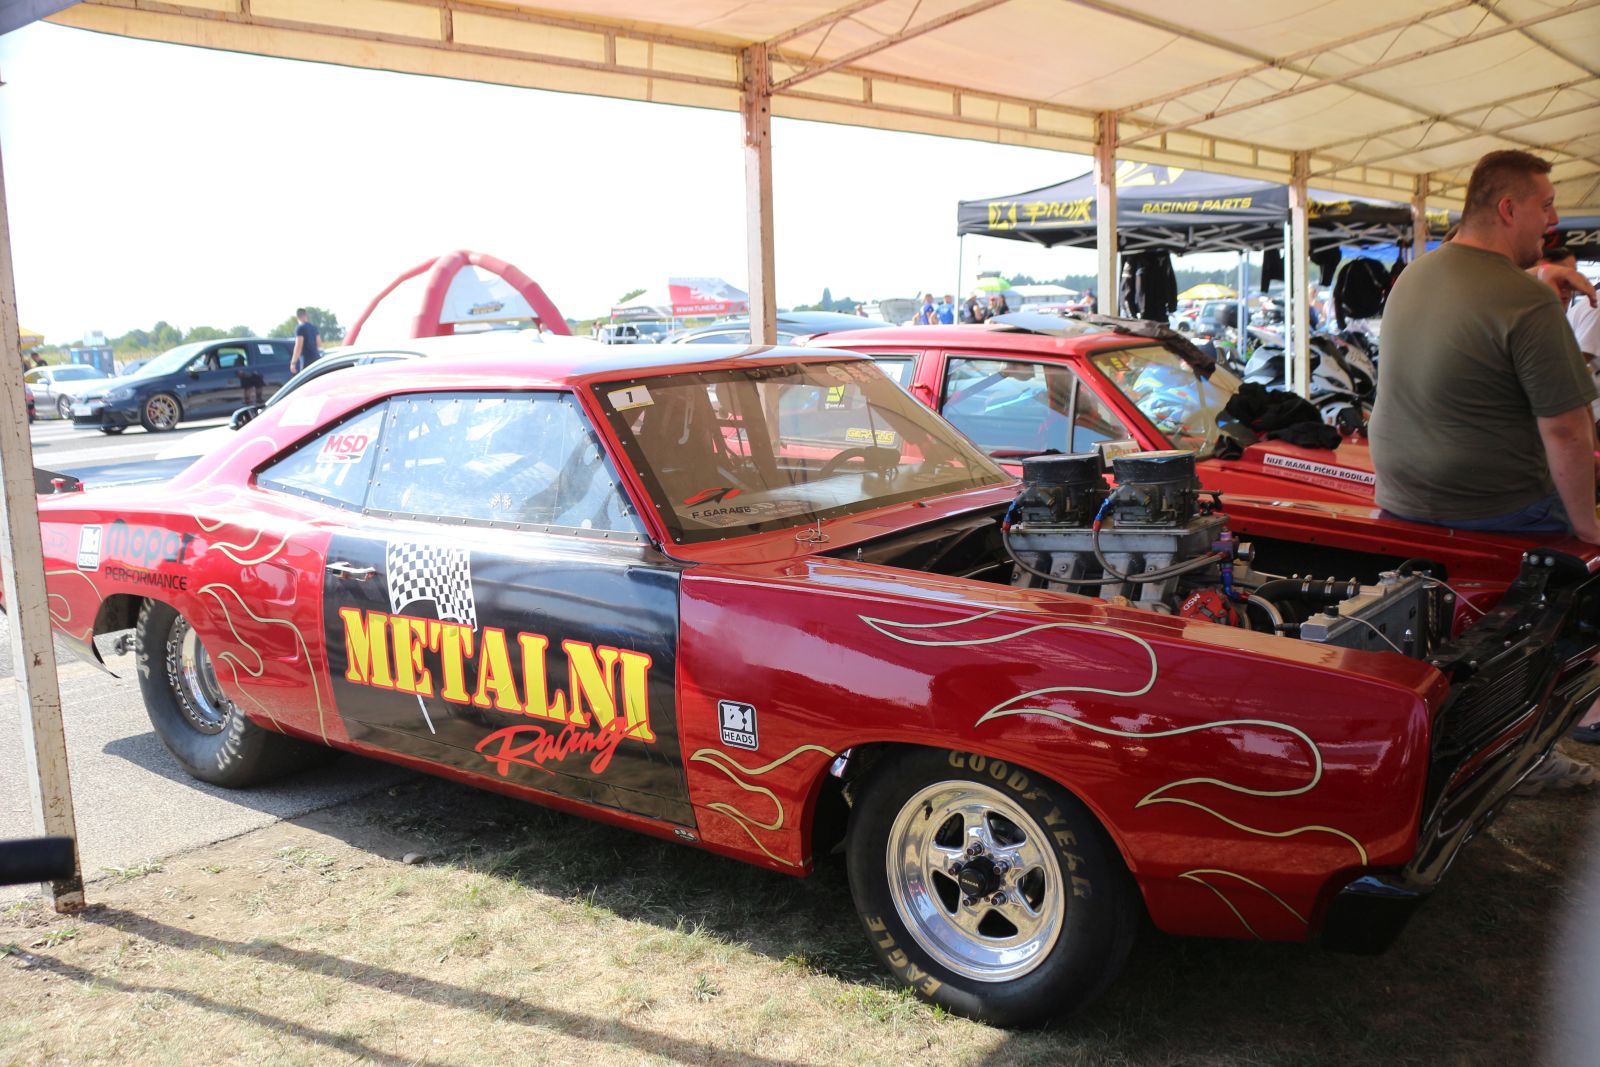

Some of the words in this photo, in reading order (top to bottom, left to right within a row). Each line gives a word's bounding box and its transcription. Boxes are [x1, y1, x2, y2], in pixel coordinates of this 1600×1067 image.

[1141, 201, 1199, 214] RACING
[1201, 197, 1253, 211] PARTS
[625, 391, 634, 403] 1
[323, 434, 369, 453] MSD
[1266, 456, 1283, 466] NIJE
[1285, 460, 1312, 472] MAMA
[1339, 469, 1374, 484] RODILA!
[692, 511, 700, 519] F
[703, 506, 752, 517] GARAGE
[104, 565, 188, 591] PERFORMANCE
[1183, 593, 1201, 611] MSD
[339, 607, 657, 744] METALNI
[475, 716, 648, 777] Racing
[723, 730, 754, 745] HEADS
[865, 915, 942, 998] EAGLE
